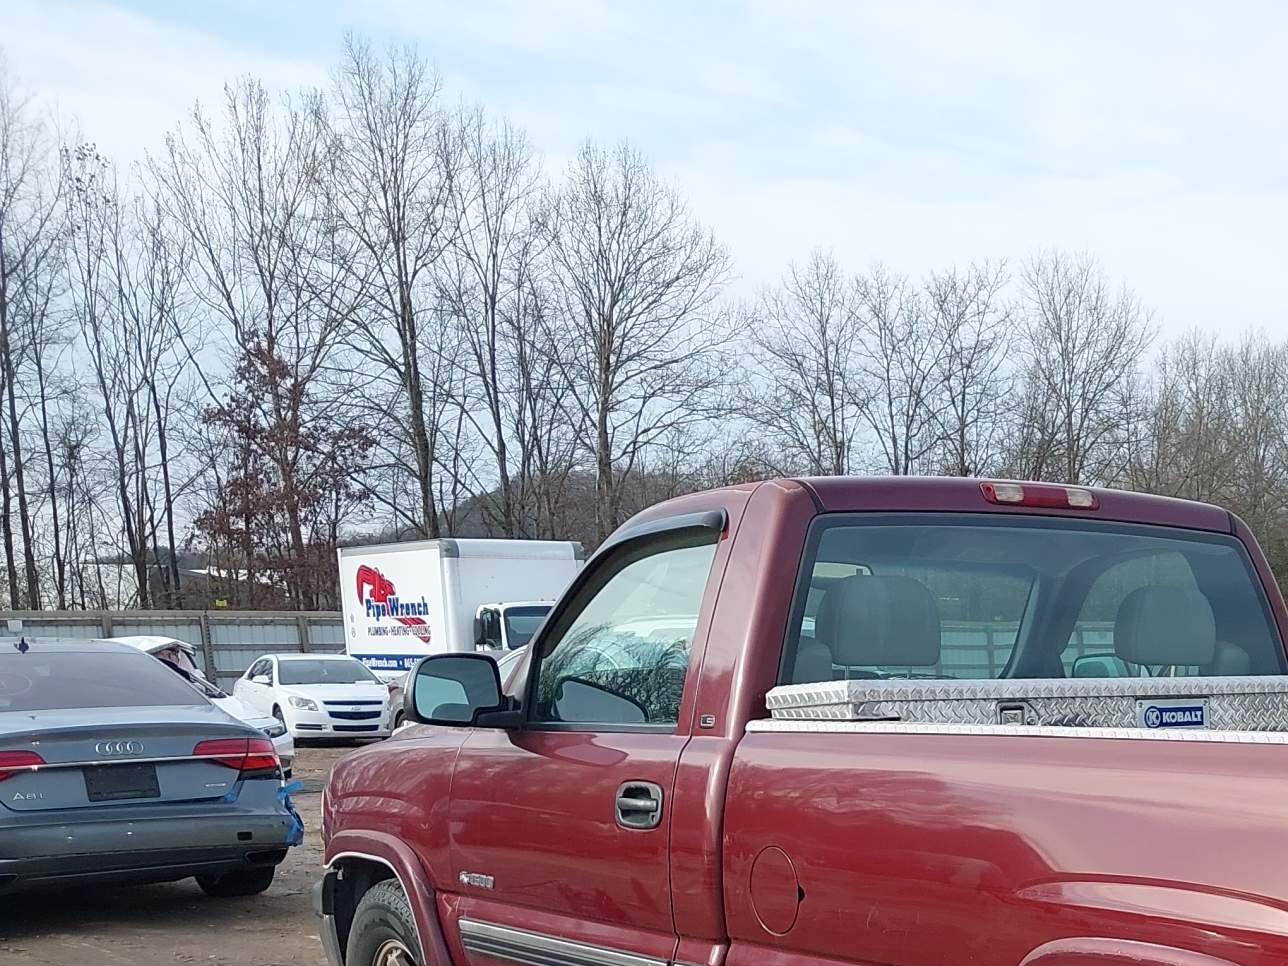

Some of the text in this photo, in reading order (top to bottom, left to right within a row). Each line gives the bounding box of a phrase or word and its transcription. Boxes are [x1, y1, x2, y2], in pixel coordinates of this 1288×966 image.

[365, 596, 429, 621] Pipe Wrench
[1162, 710, 1202, 724] KOBALT
